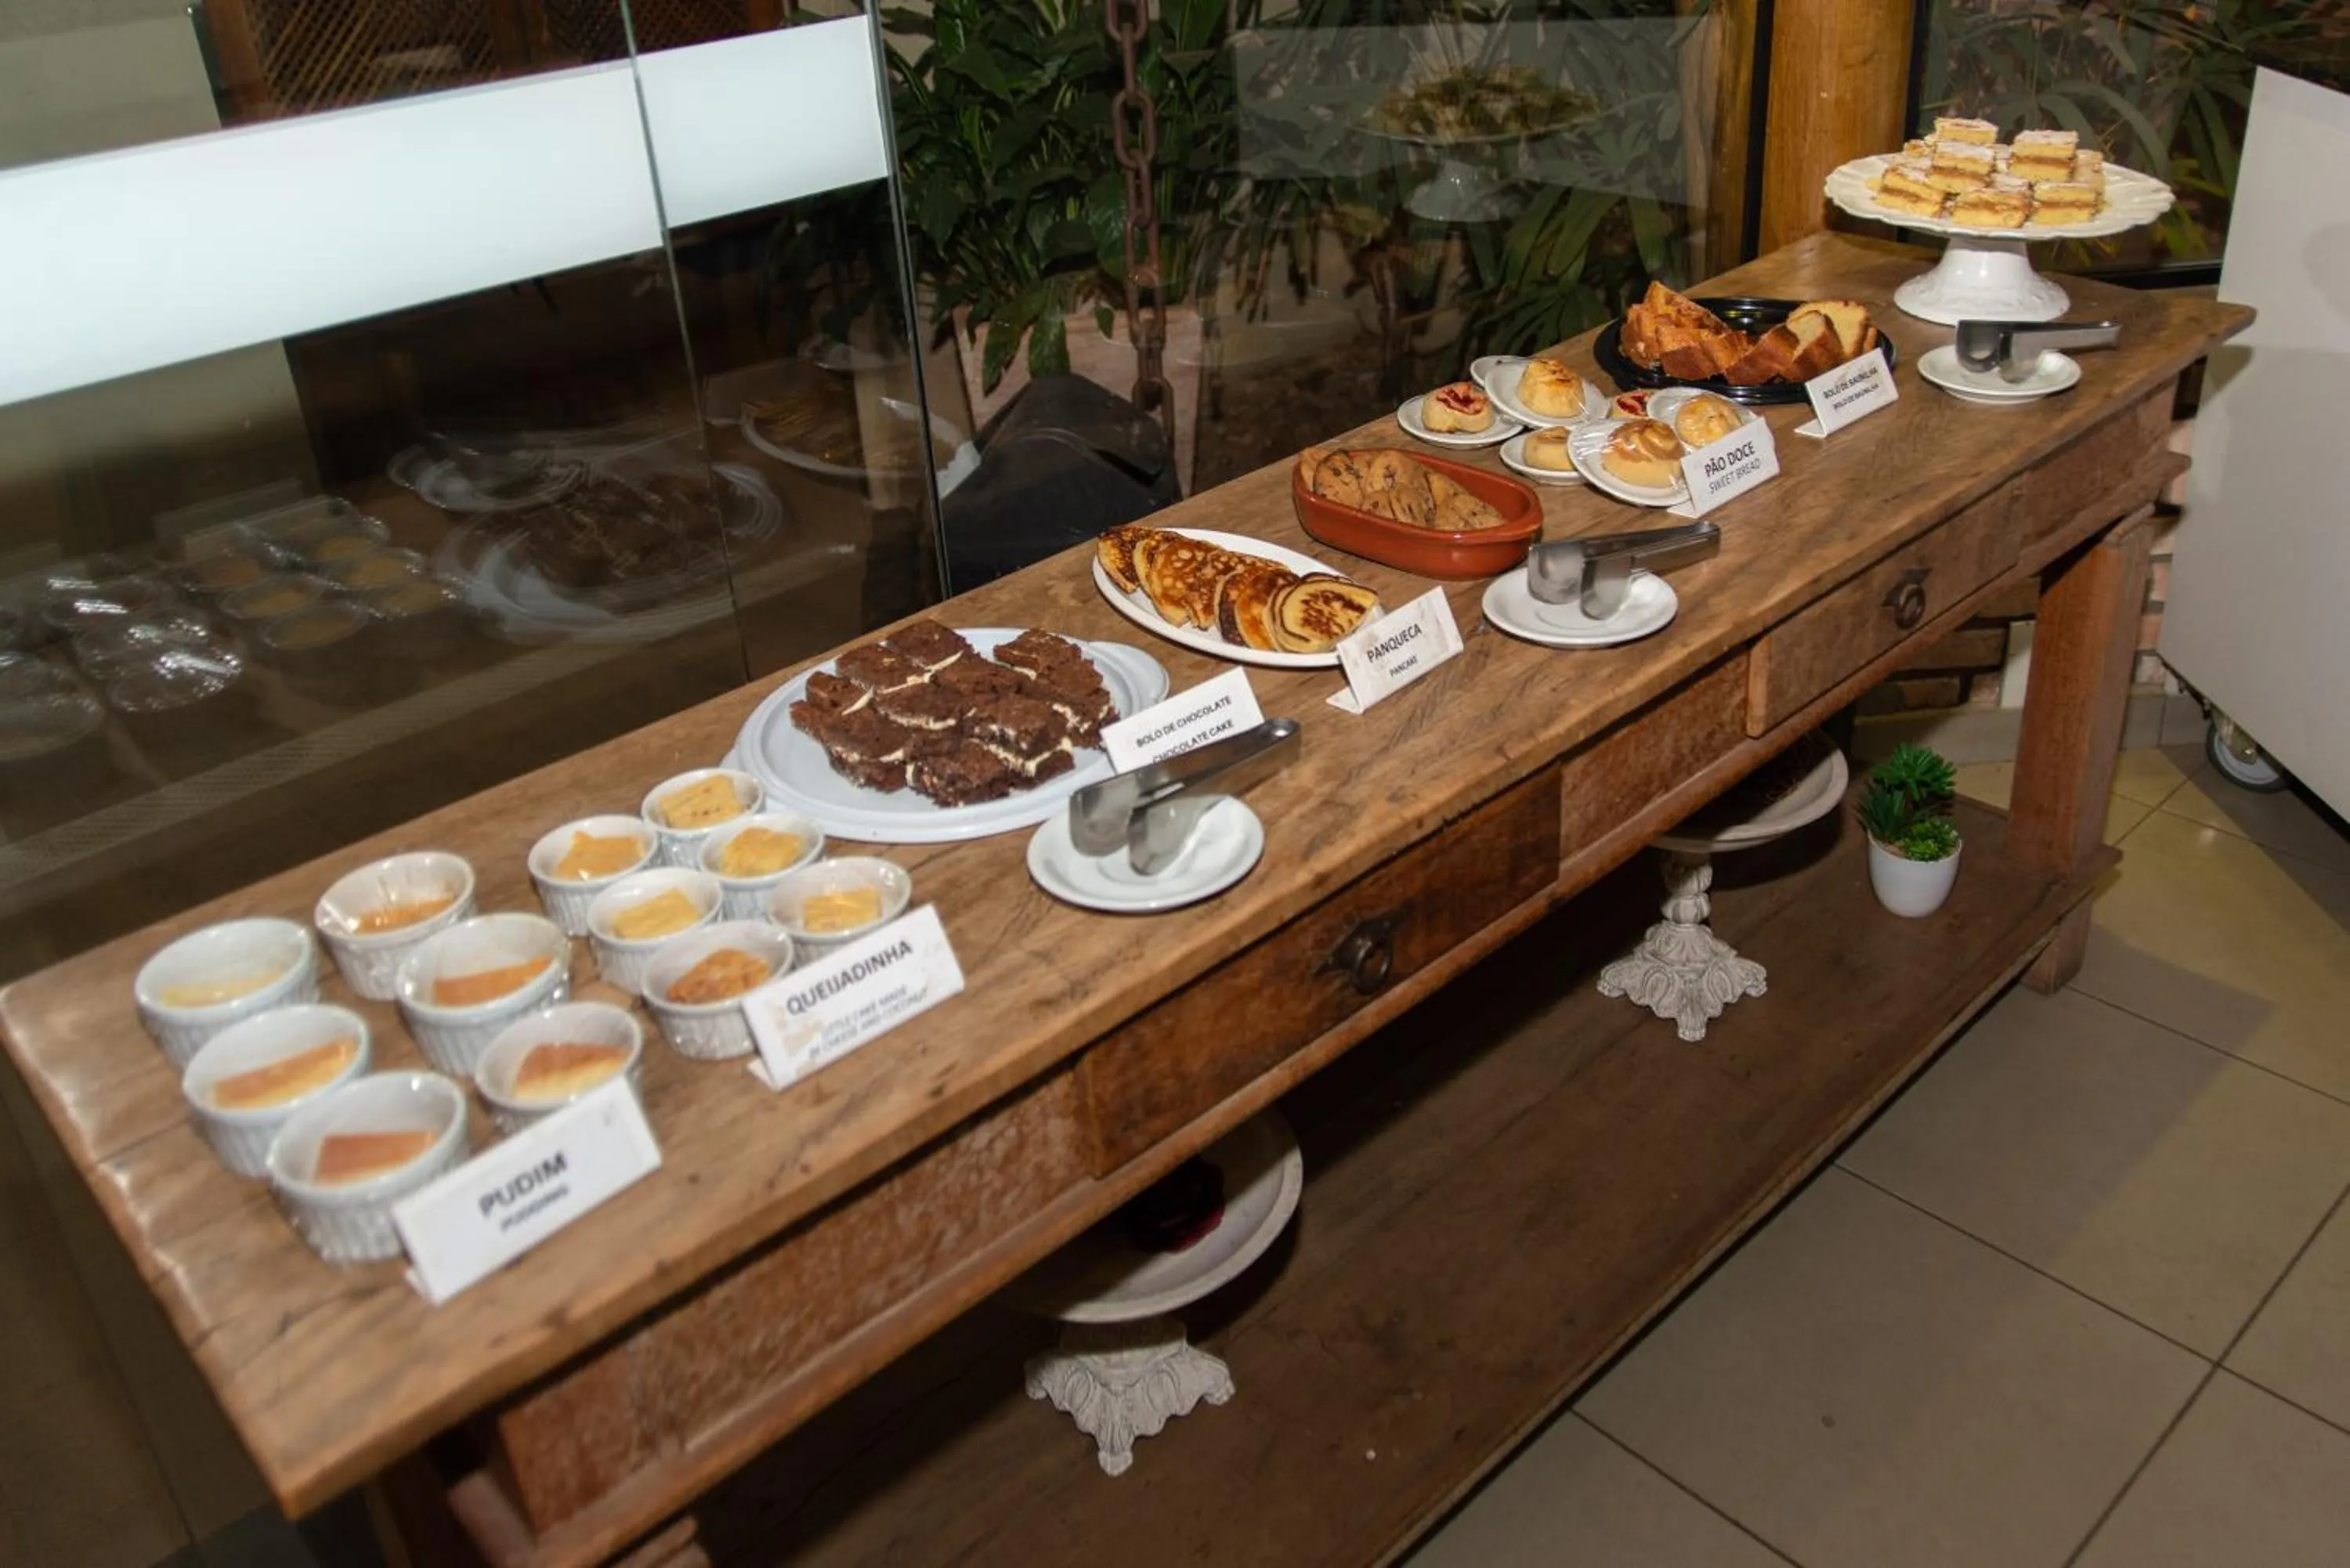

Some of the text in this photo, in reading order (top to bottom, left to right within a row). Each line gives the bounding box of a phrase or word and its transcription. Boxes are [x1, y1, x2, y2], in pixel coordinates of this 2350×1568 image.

[1704, 440, 1755, 478] PÃO DOCE
[1708, 458, 1762, 494] SWEET BREAD
[1366, 623, 1423, 663] PANQUECA
[1136, 695, 1232, 748] BOLO DE CHOCOLATE
[1208, 719, 1235, 737] CAKE
[786, 939, 913, 1016] QUEIJADINHA
[478, 1150, 568, 1218] PUDIM
